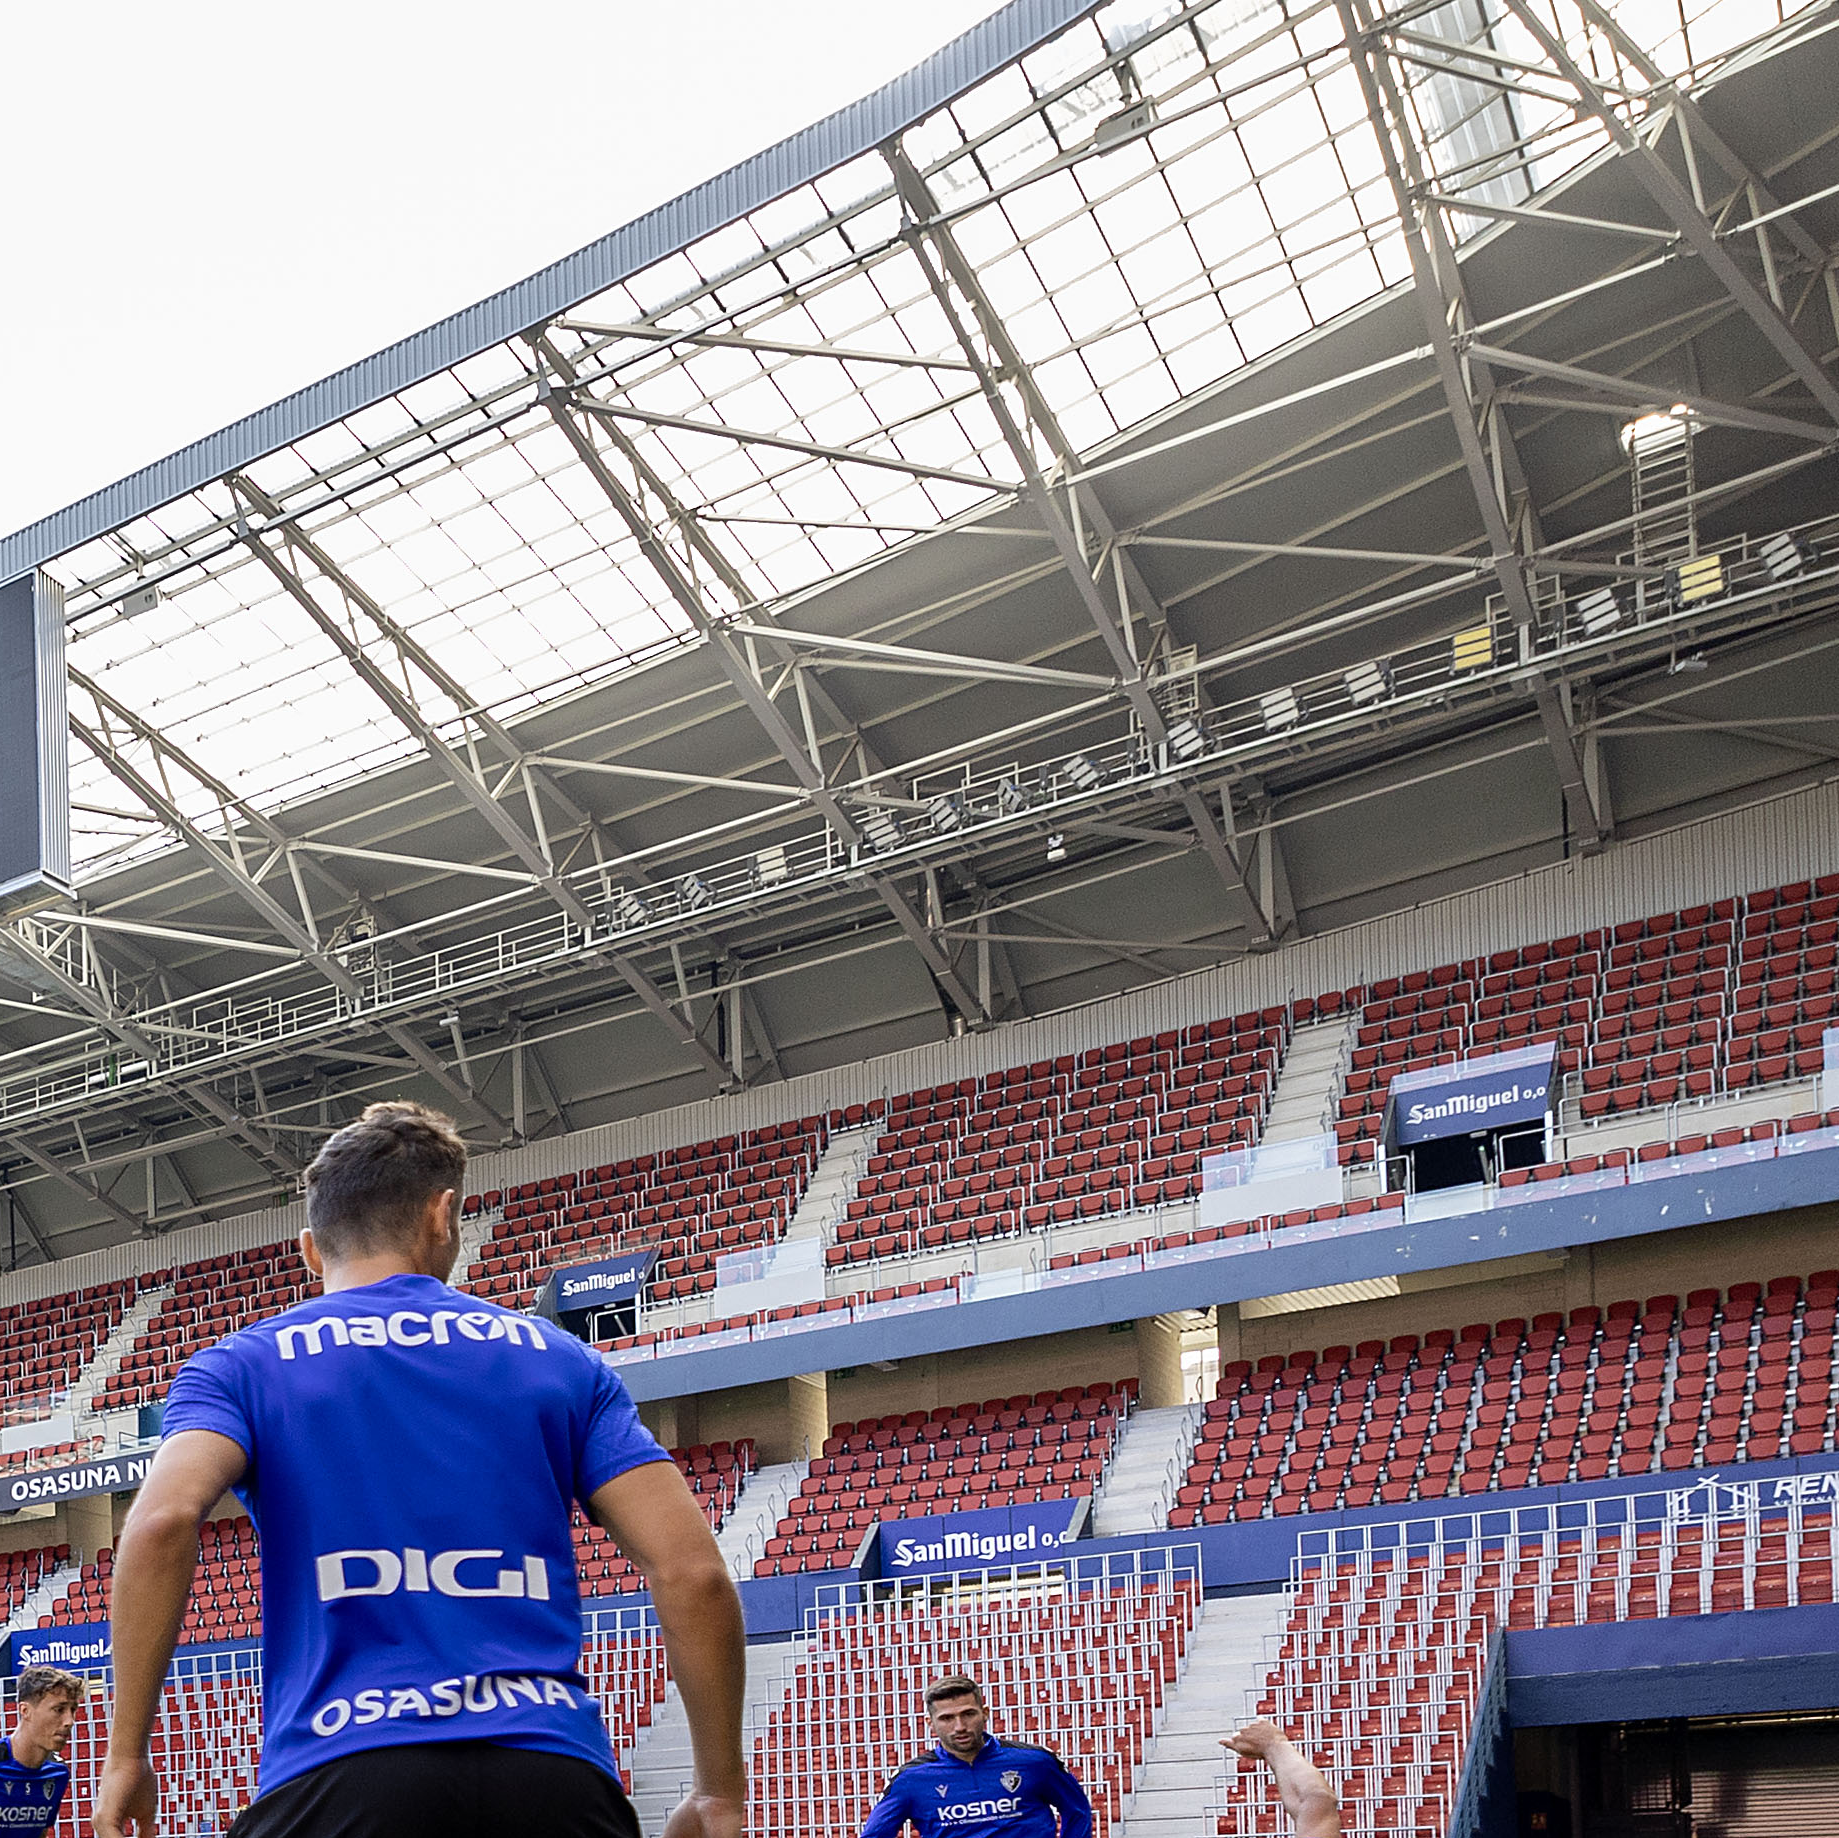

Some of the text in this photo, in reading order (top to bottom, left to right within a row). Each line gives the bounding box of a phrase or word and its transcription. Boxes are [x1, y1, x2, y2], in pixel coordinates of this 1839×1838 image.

[1405, 1085, 1519, 1125] SanMiguel
[561, 1267, 635, 1296] SanMiguel
[275, 1311, 548, 1360] macron
[10, 1465, 122, 1502] OSASUNA
[891, 1525, 1036, 1568] SanMiguel
[316, 1547, 550, 1602] DIGI
[17, 1638, 104, 1667] SanMiguel
[310, 1675, 579, 1737] OSASUNA
